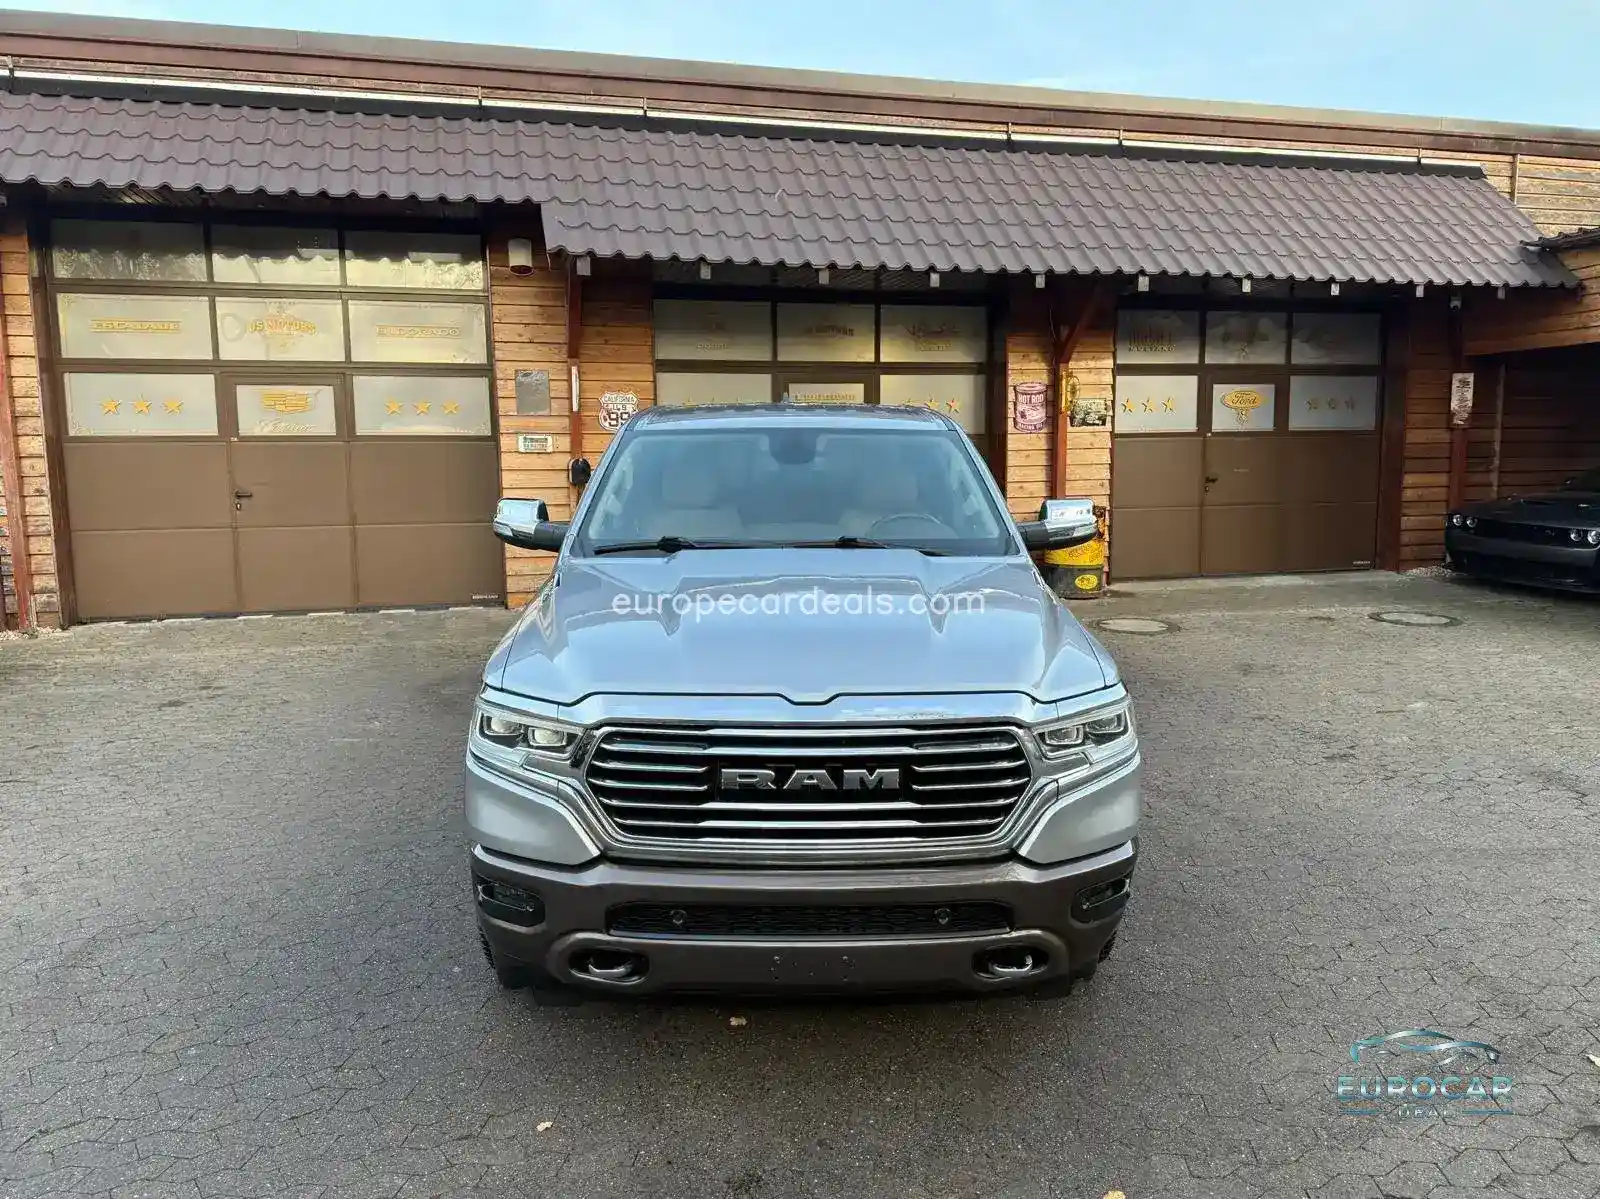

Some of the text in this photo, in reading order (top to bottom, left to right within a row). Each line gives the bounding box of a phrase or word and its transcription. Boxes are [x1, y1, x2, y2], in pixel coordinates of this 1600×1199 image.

[1018, 394, 1044, 404] HOT ROD
[1231, 394, 1258, 406] Ford
[720, 767, 901, 791] RAM
